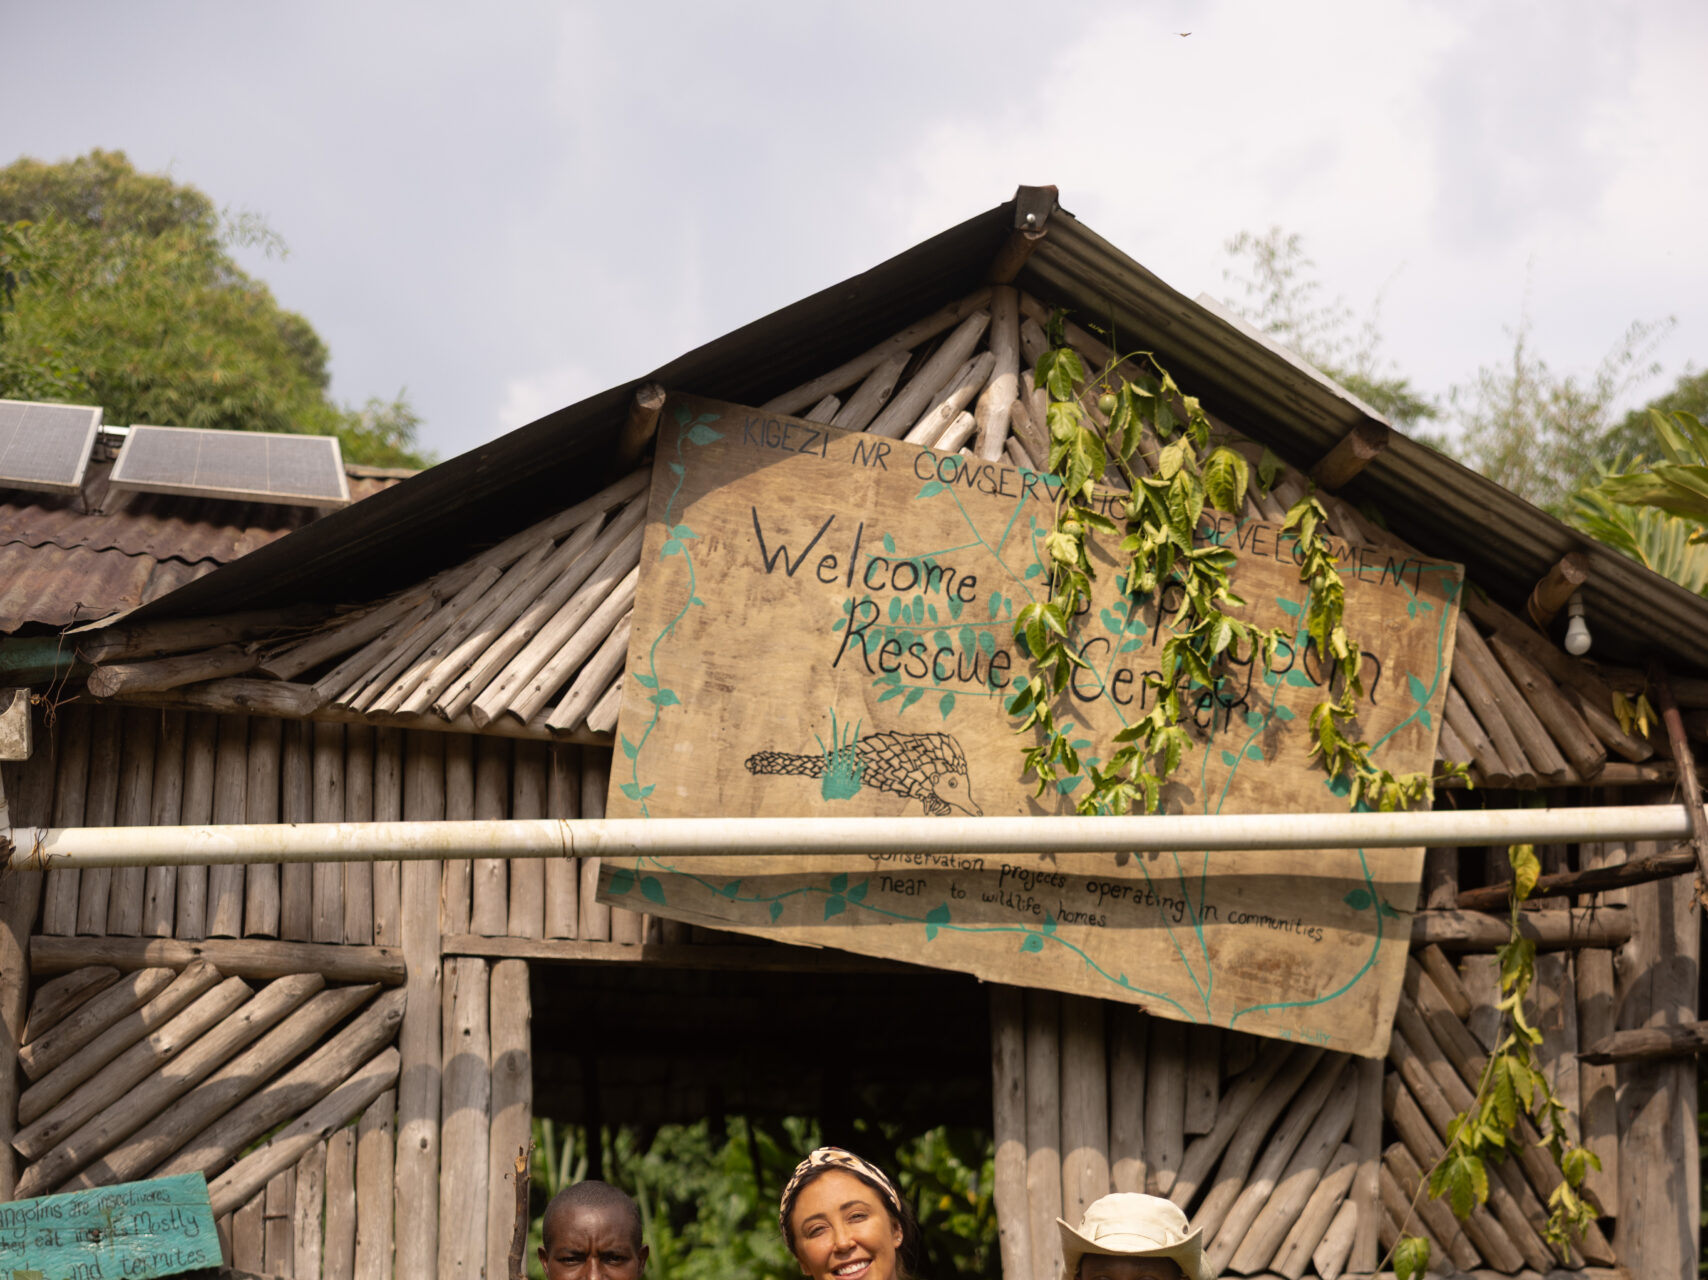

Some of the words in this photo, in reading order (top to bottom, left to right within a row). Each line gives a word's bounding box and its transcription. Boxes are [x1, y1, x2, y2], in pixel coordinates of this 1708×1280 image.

[743, 416, 829, 459] KIGEZI
[751, 506, 978, 603] Welcome
[833, 596, 1012, 689] Rescue
[879, 875, 927, 897] near
[949, 881, 967, 901] to
[981, 891, 1042, 916] wildlife
[1056, 900, 1107, 928] homes
[999, 863, 1067, 892] projects
[1086, 880, 1186, 924] operating
[1198, 902, 1219, 921] in
[1227, 910, 1324, 943] communities
[133, 1208, 200, 1238] Mostly
[120, 1249, 206, 1276] termites
